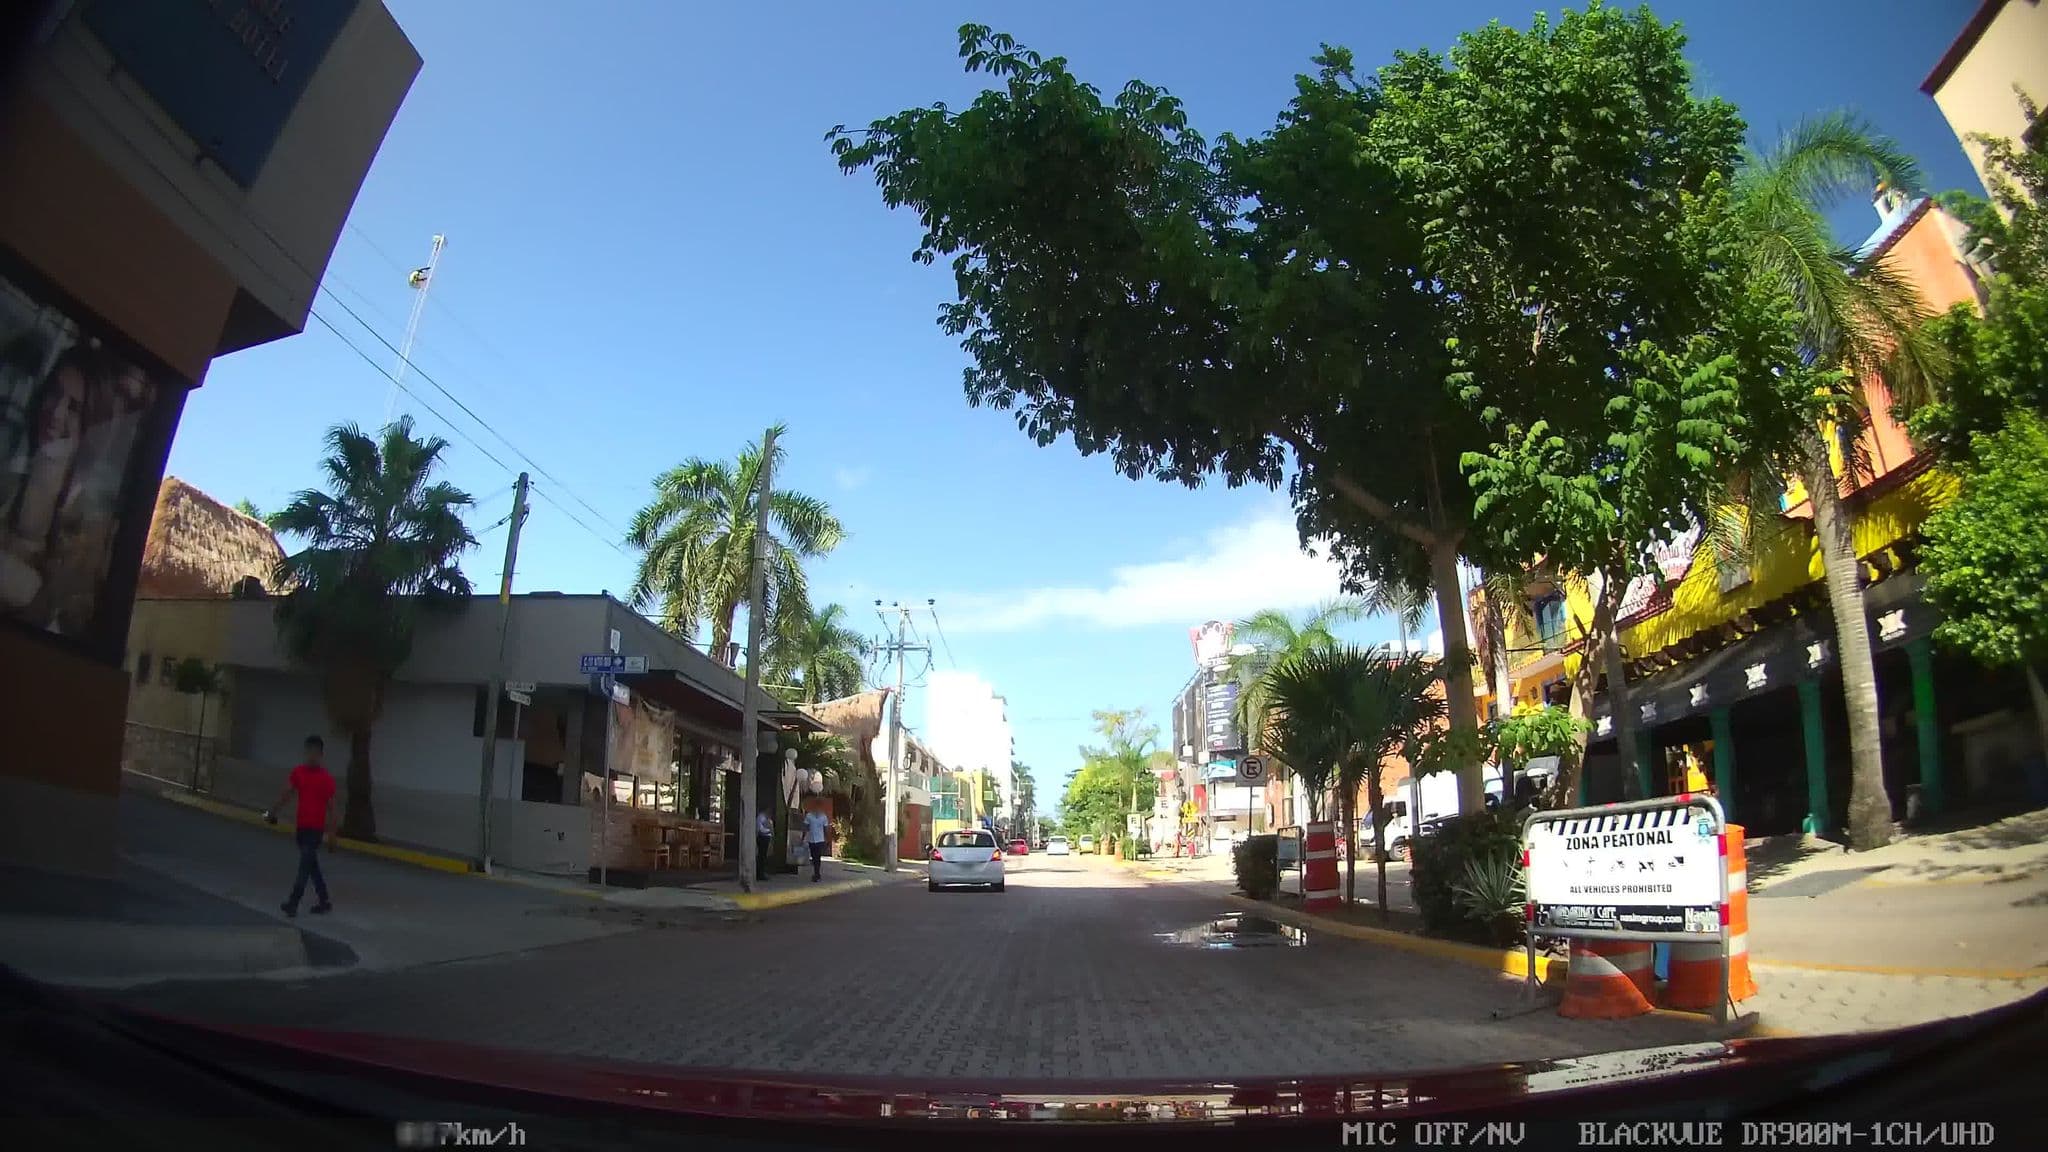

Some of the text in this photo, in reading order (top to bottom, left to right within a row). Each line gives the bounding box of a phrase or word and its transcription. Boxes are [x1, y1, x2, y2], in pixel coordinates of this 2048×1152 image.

[1566, 830, 1673, 850] ZONA PEATONAL
[1570, 884, 1672, 894] ALL VEHICLES PROHIBITED
